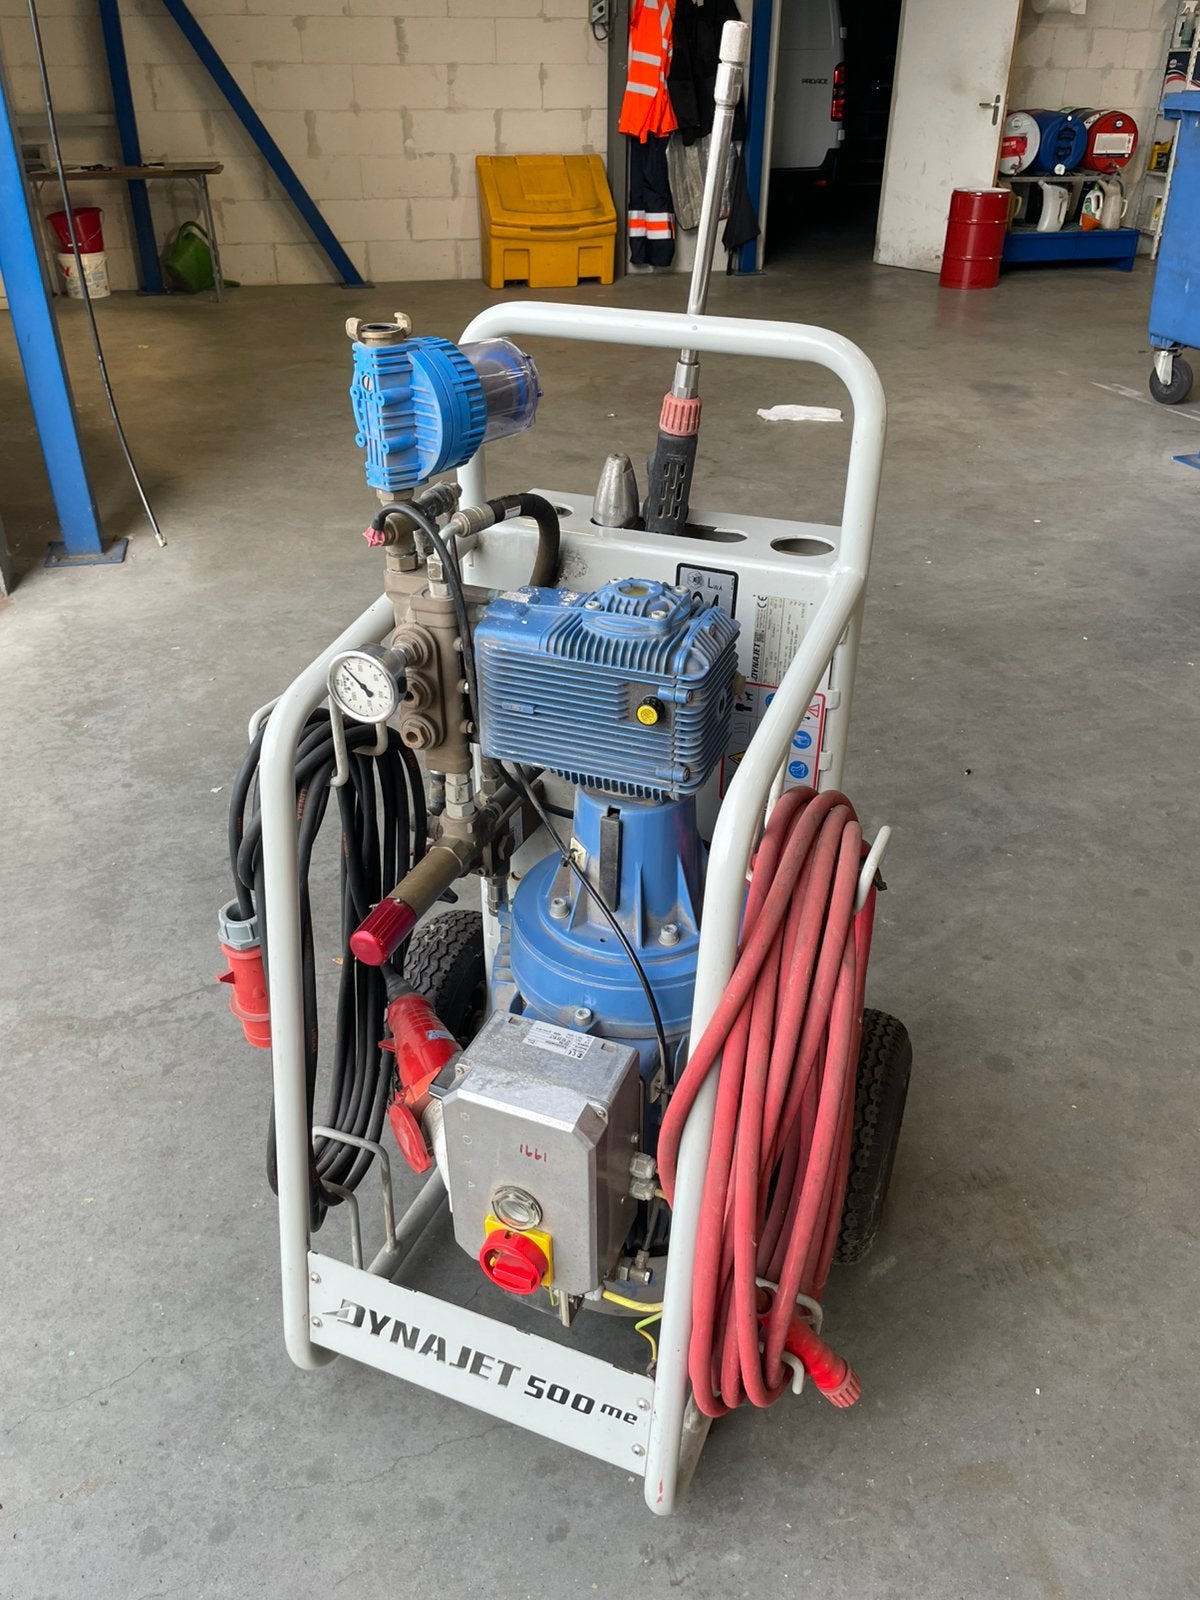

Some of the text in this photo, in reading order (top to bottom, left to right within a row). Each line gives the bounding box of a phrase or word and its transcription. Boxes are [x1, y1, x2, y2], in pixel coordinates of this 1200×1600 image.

[751, 643, 761, 681] DYNAJET
[322, 1298, 638, 1425] DYNAJET 500 me
